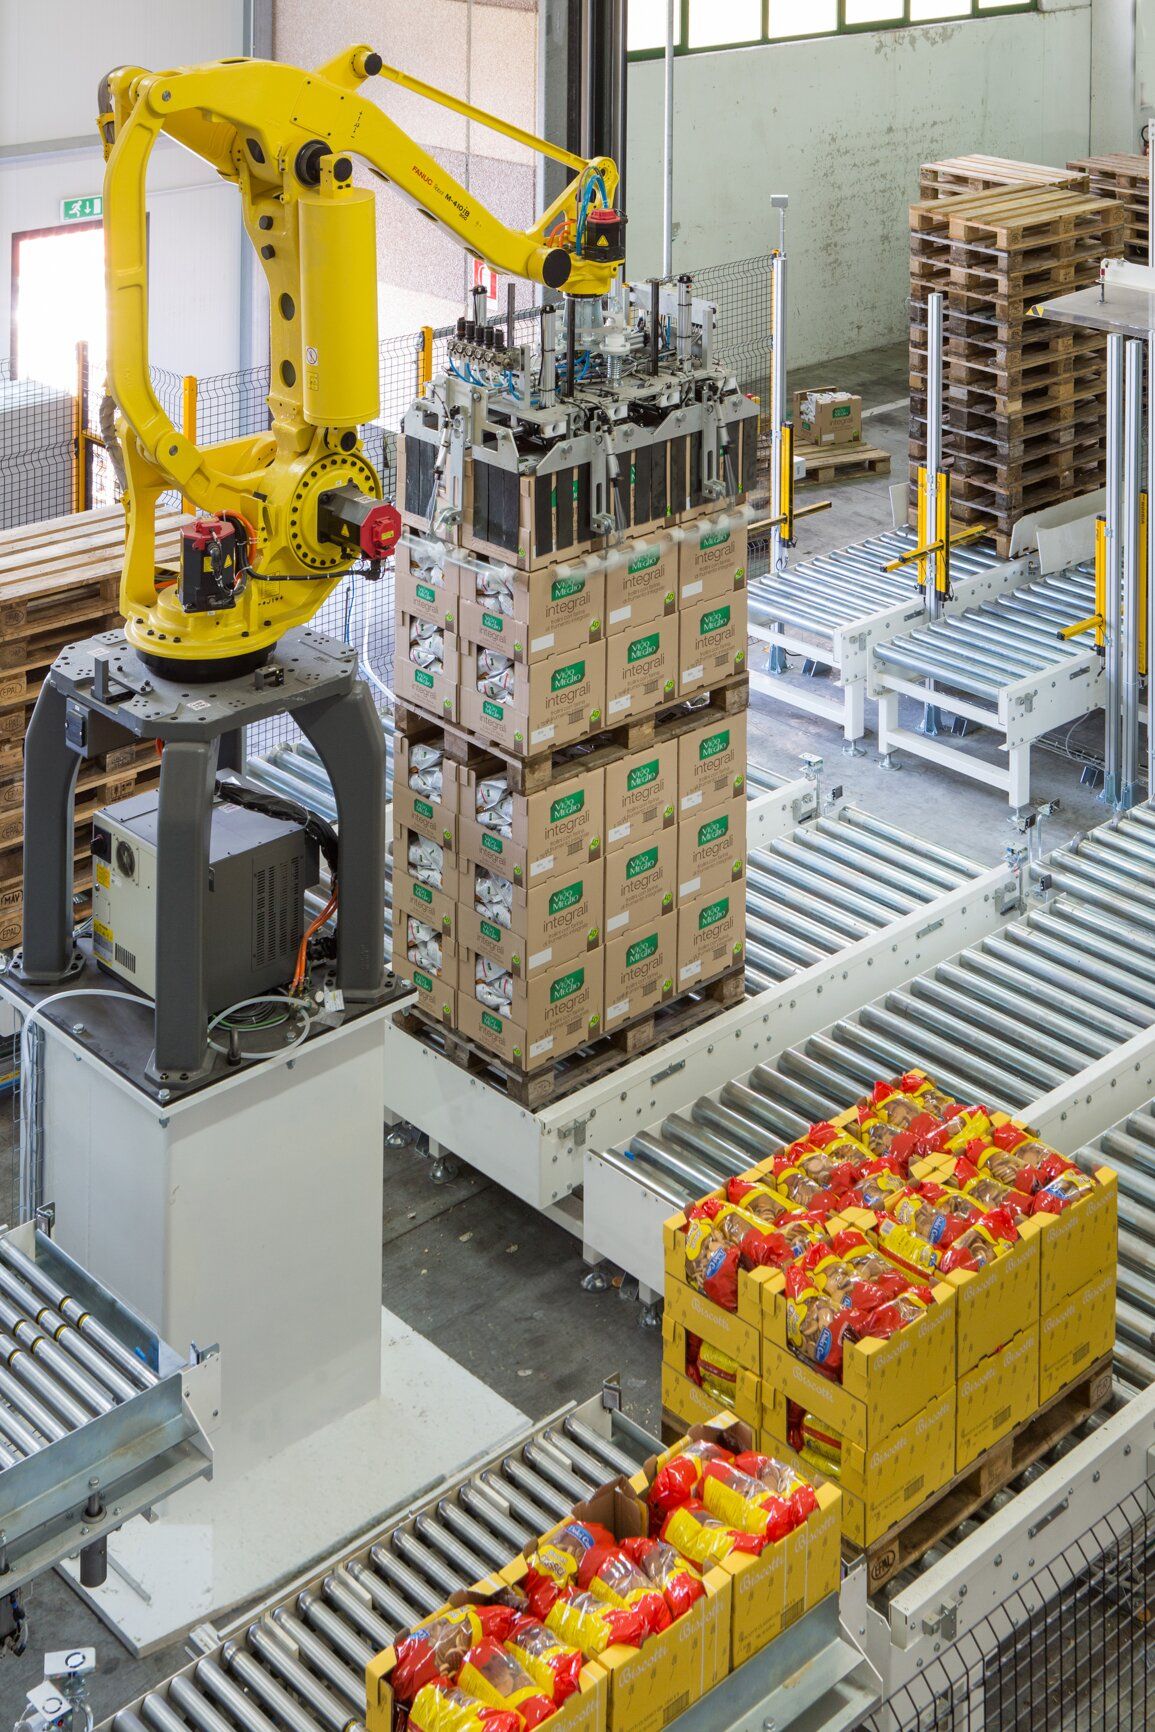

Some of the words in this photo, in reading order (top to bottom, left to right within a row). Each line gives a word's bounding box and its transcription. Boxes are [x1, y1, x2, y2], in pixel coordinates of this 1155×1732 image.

[412, 166, 433, 186] FANUC
[695, 540, 735, 566] integrali
[622, 564, 665, 590] integrali
[545, 592, 591, 618] integrali
[696, 625, 735, 649] integrali
[622, 653, 665, 679] integrali
[545, 682, 591, 709] integrali
[695, 750, 734, 776] integrali
[622, 781, 665, 808] integrali
[544, 813, 590, 840] integrali
[694, 837, 733, 864] integrali
[621, 869, 664, 896] integrali
[544, 904, 589, 933] integrali
[695, 919, 734, 945] integrali
[621, 957, 664, 984] integrali
[545, 992, 590, 1021] integrali
